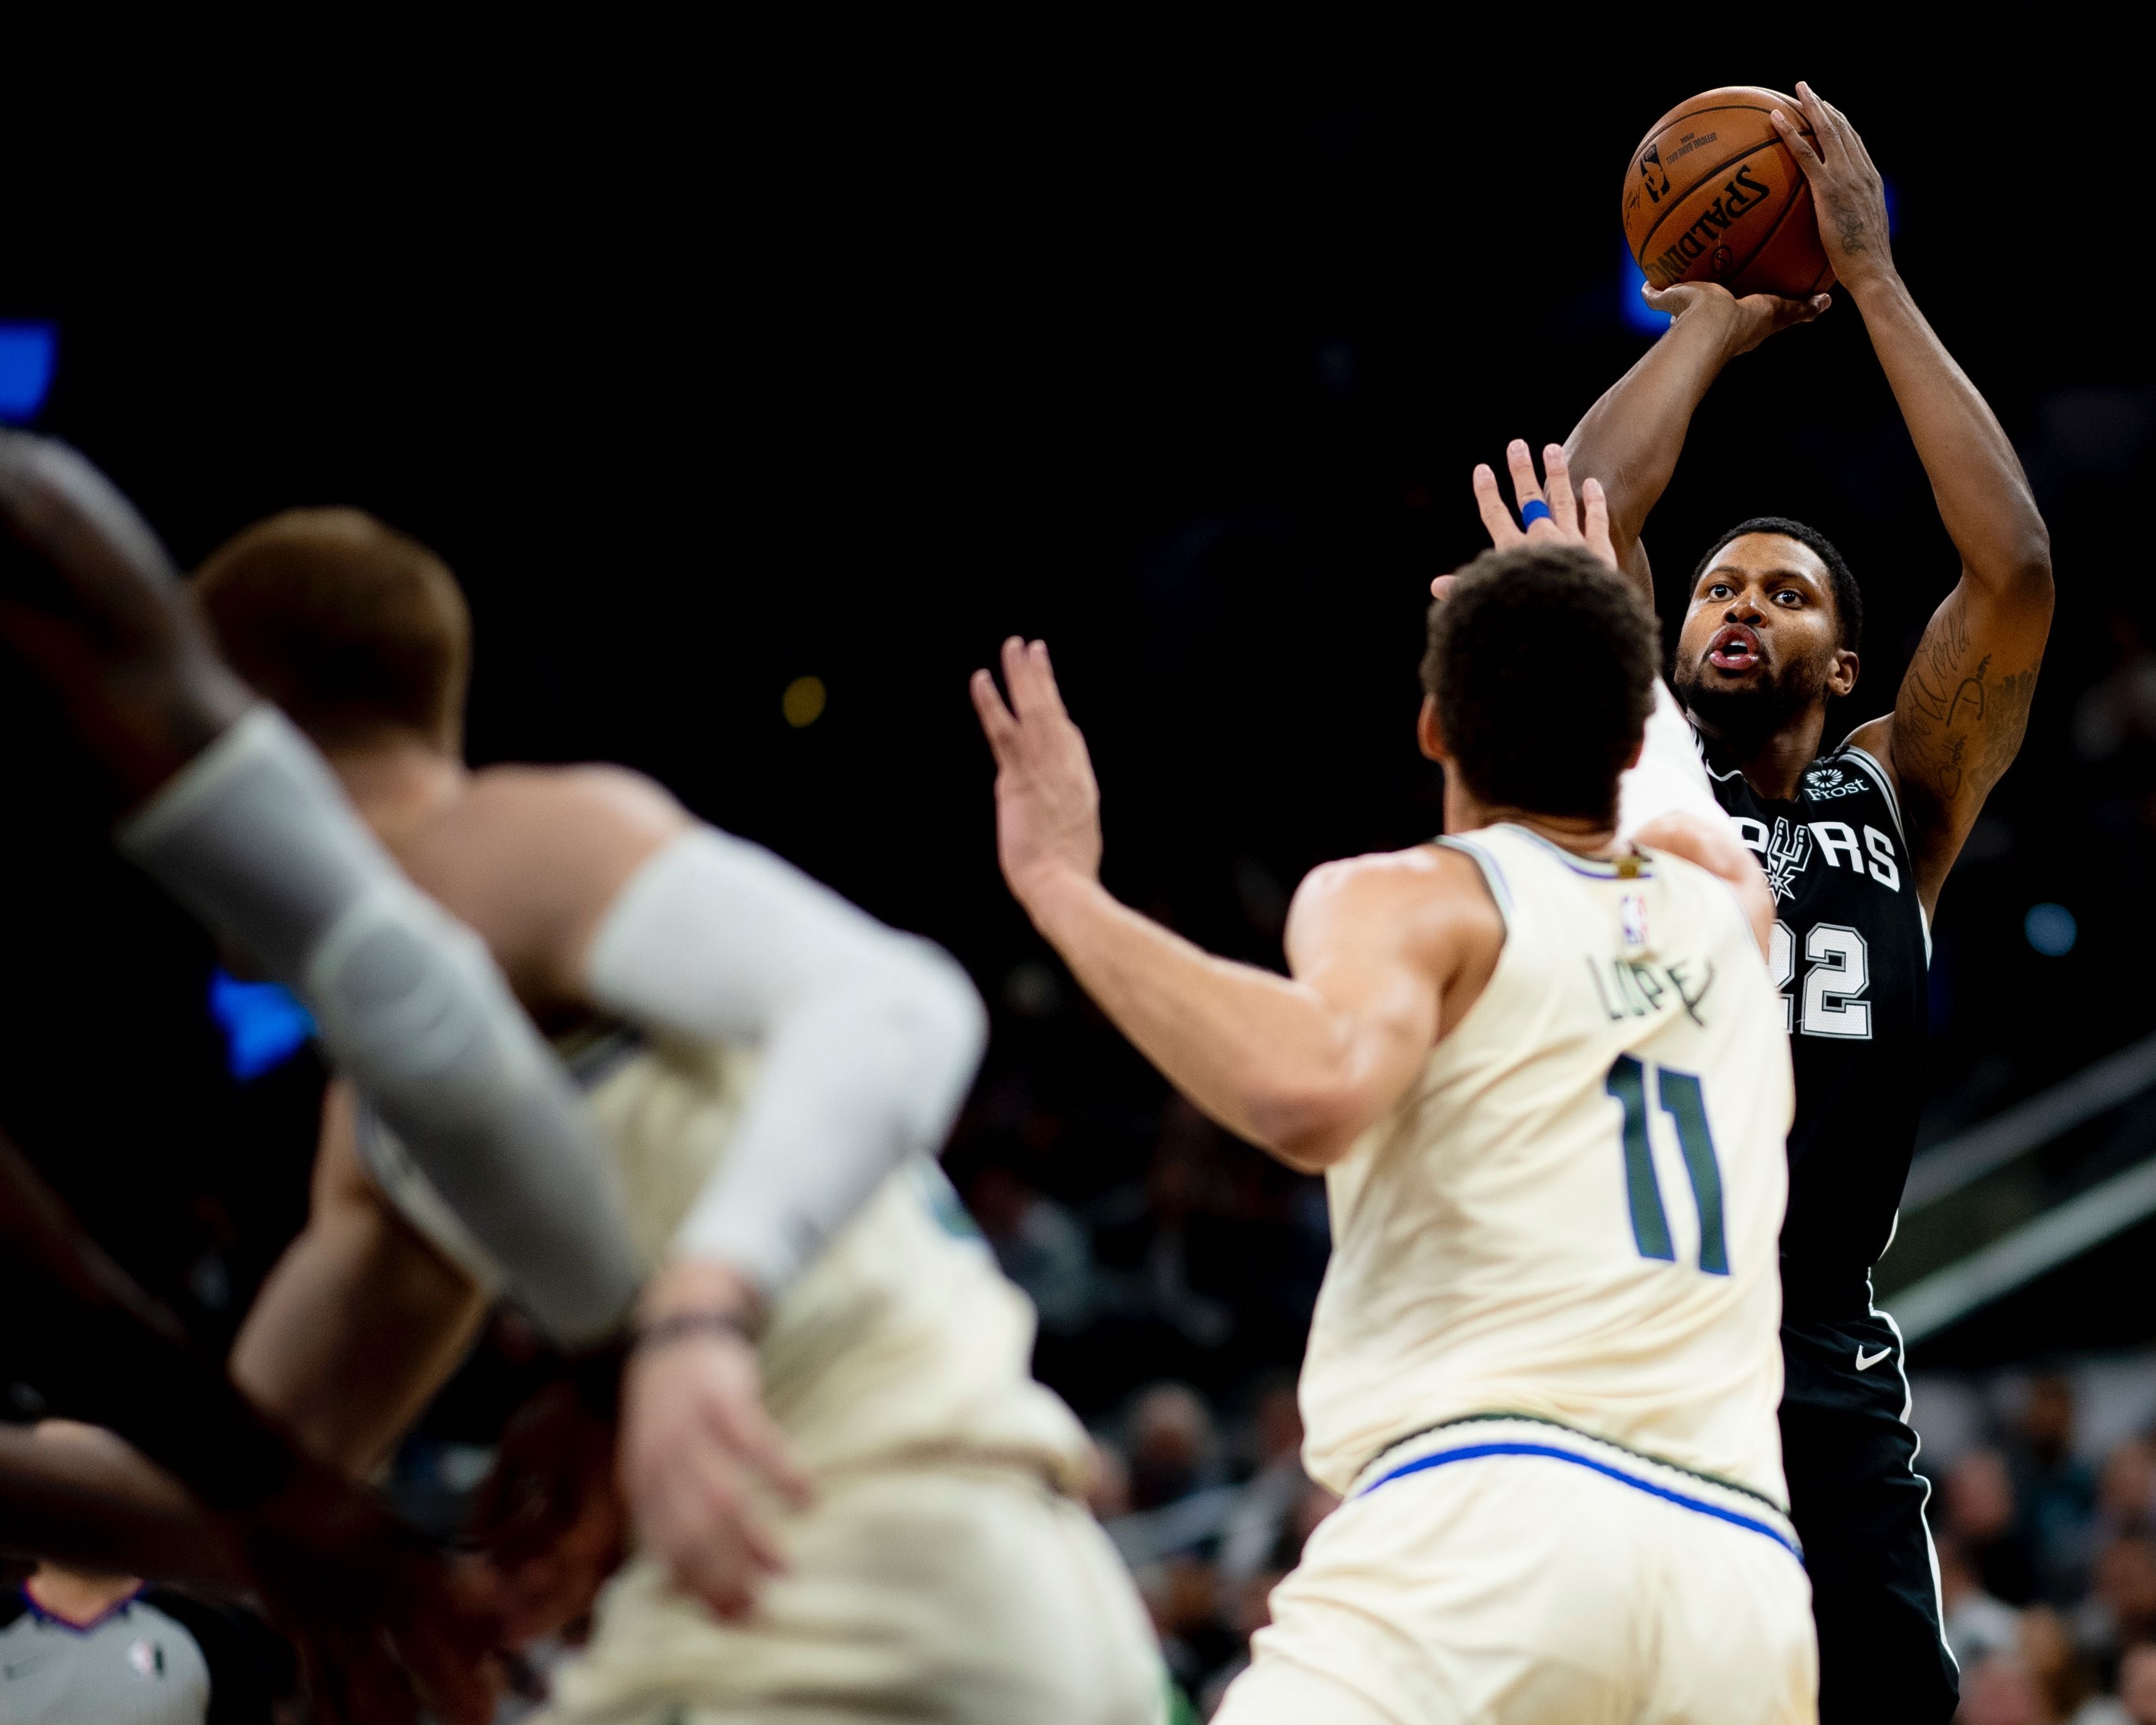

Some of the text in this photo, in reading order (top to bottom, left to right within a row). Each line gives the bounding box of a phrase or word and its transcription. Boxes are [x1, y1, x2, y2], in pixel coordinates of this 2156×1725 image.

[1692, 132, 1717, 149] OFFICIAL
[1666, 151, 1679, 166] BALL
[1677, 142, 1694, 158] GAME
[1805, 779, 1869, 800] Frost
[1603, 1052, 1730, 1276] 11
